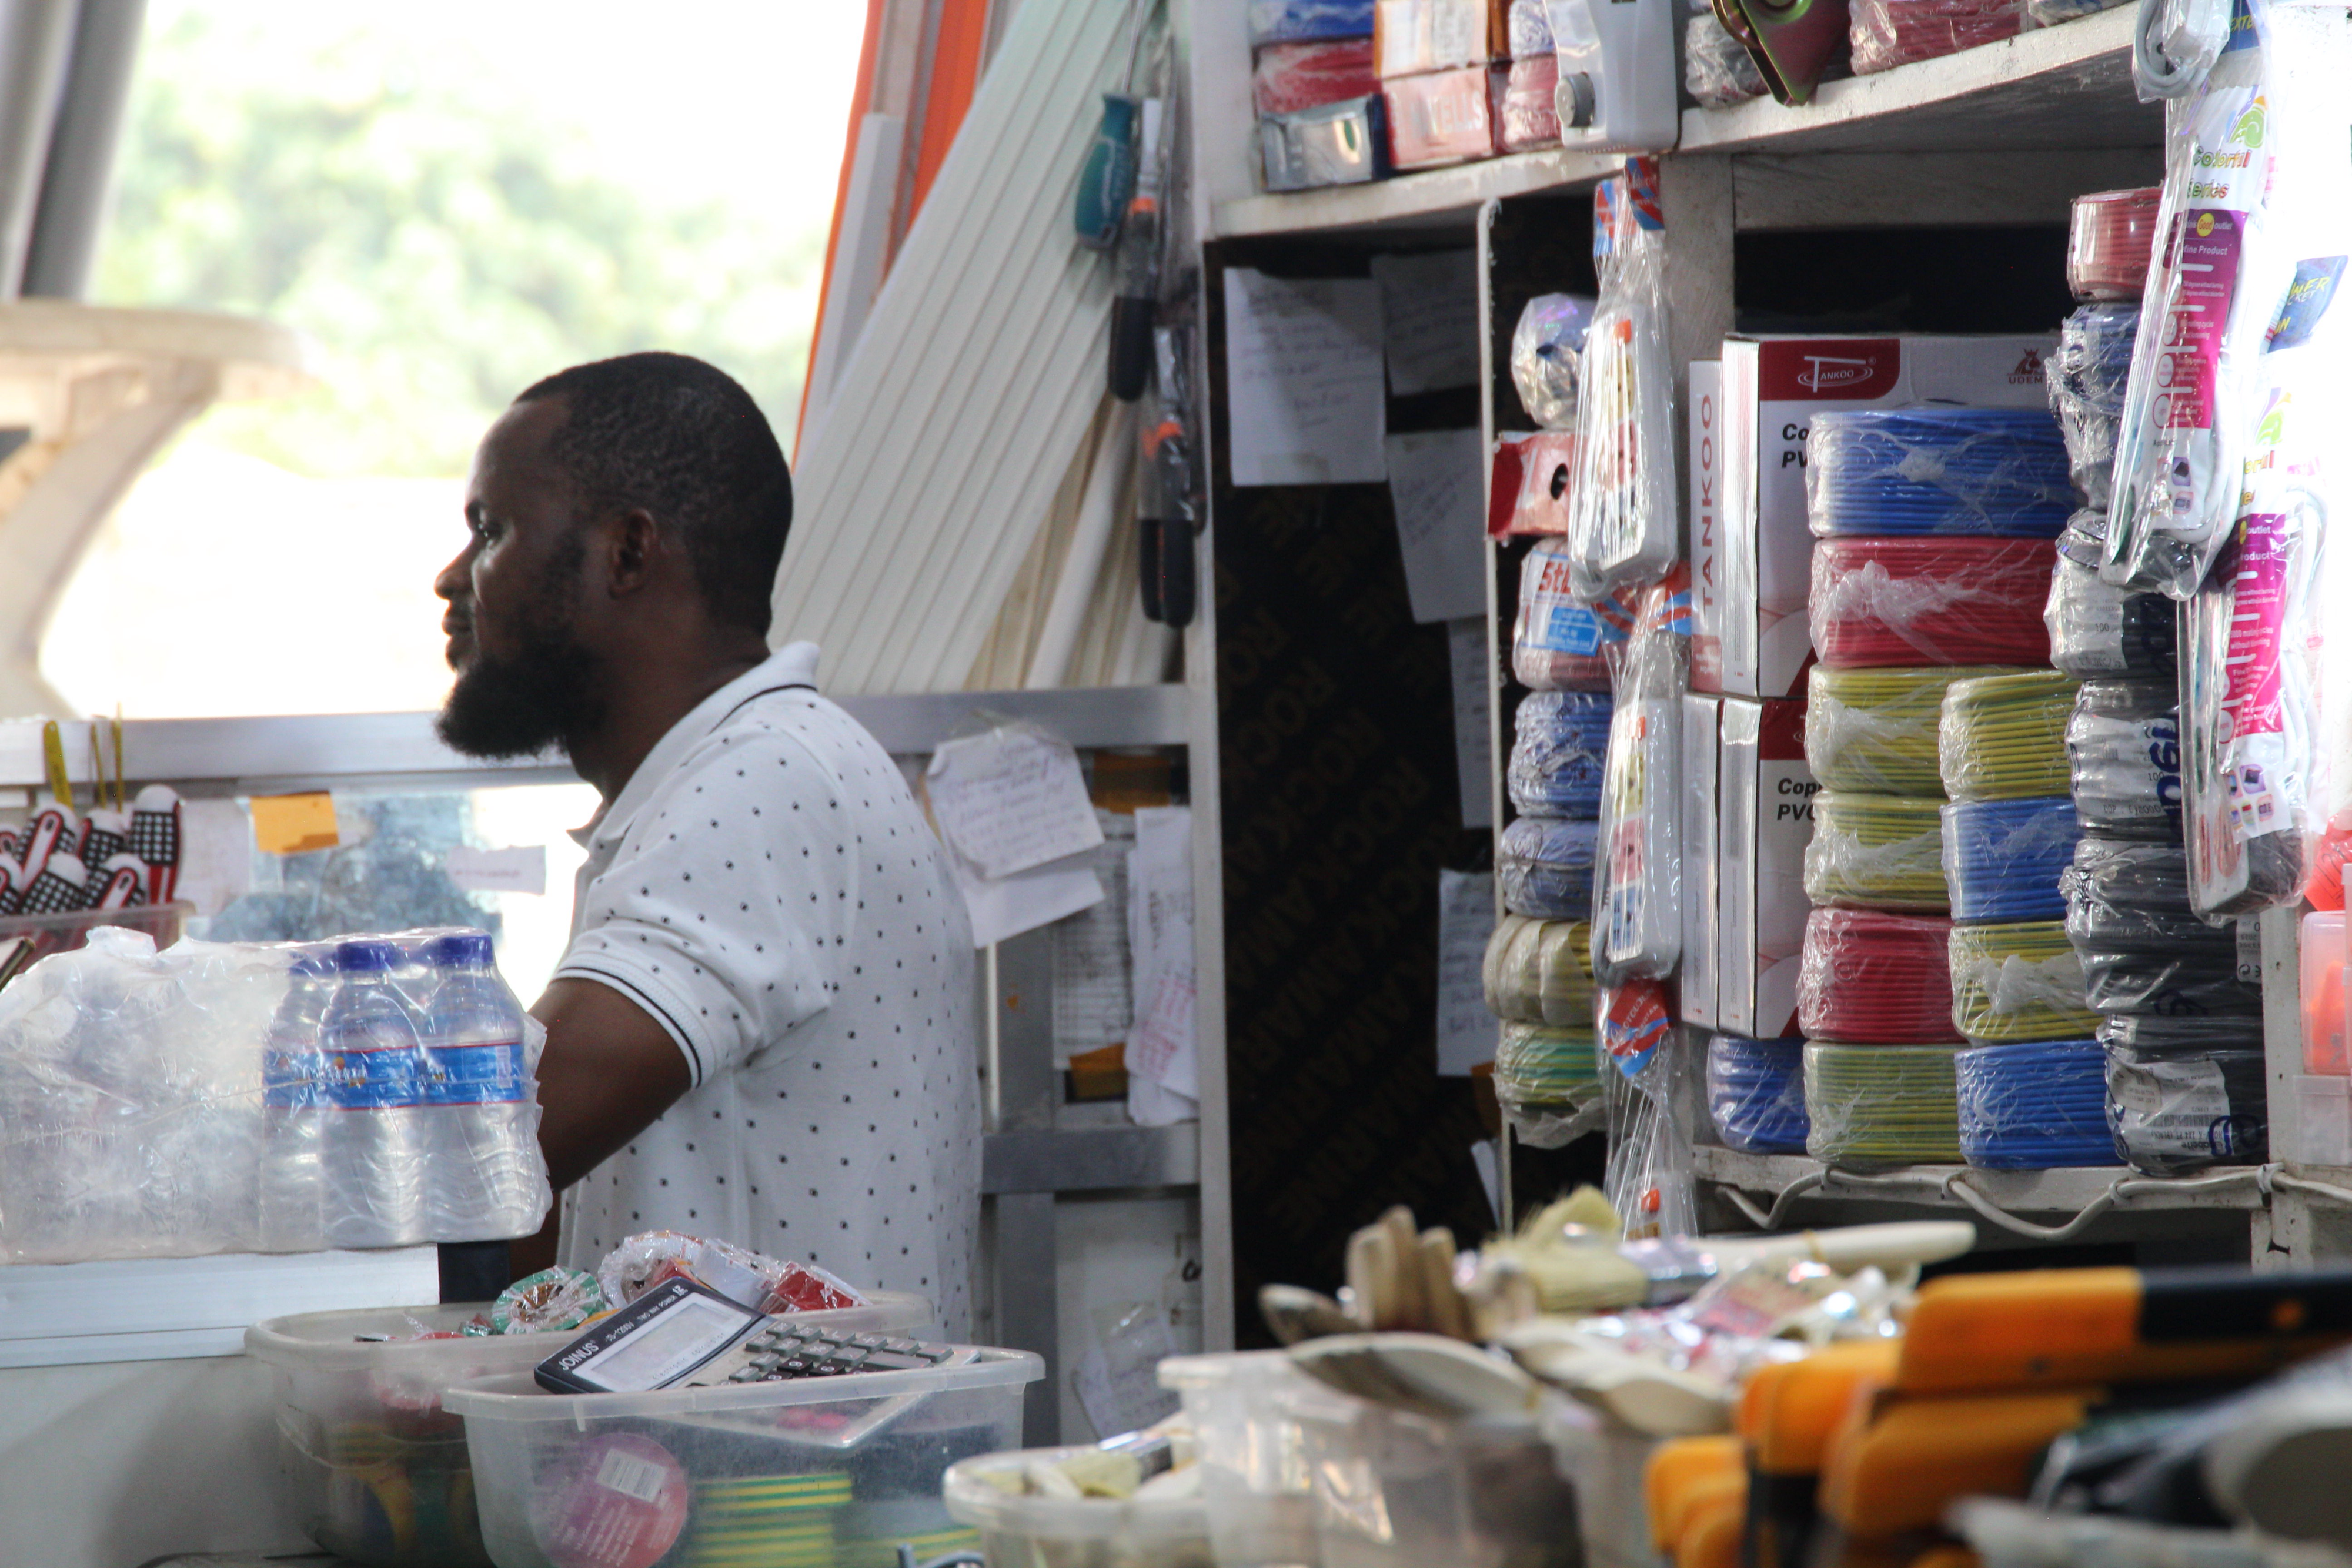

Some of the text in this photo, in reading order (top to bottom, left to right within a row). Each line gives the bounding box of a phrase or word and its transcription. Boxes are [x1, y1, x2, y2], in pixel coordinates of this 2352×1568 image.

[2198, 245, 2228, 255] Product
[2009, 375, 2043, 384] UDEM
[1782, 423, 1809, 441] Co
[1782, 451, 1808, 469] PV
[1702, 394, 1713, 606] TANKOO
[2247, 526, 2271, 534] outlet
[2240, 551, 2270, 561] roduct
[1778, 777, 1823, 798] Cop
[559, 1342, 599, 1371] JOINUS
